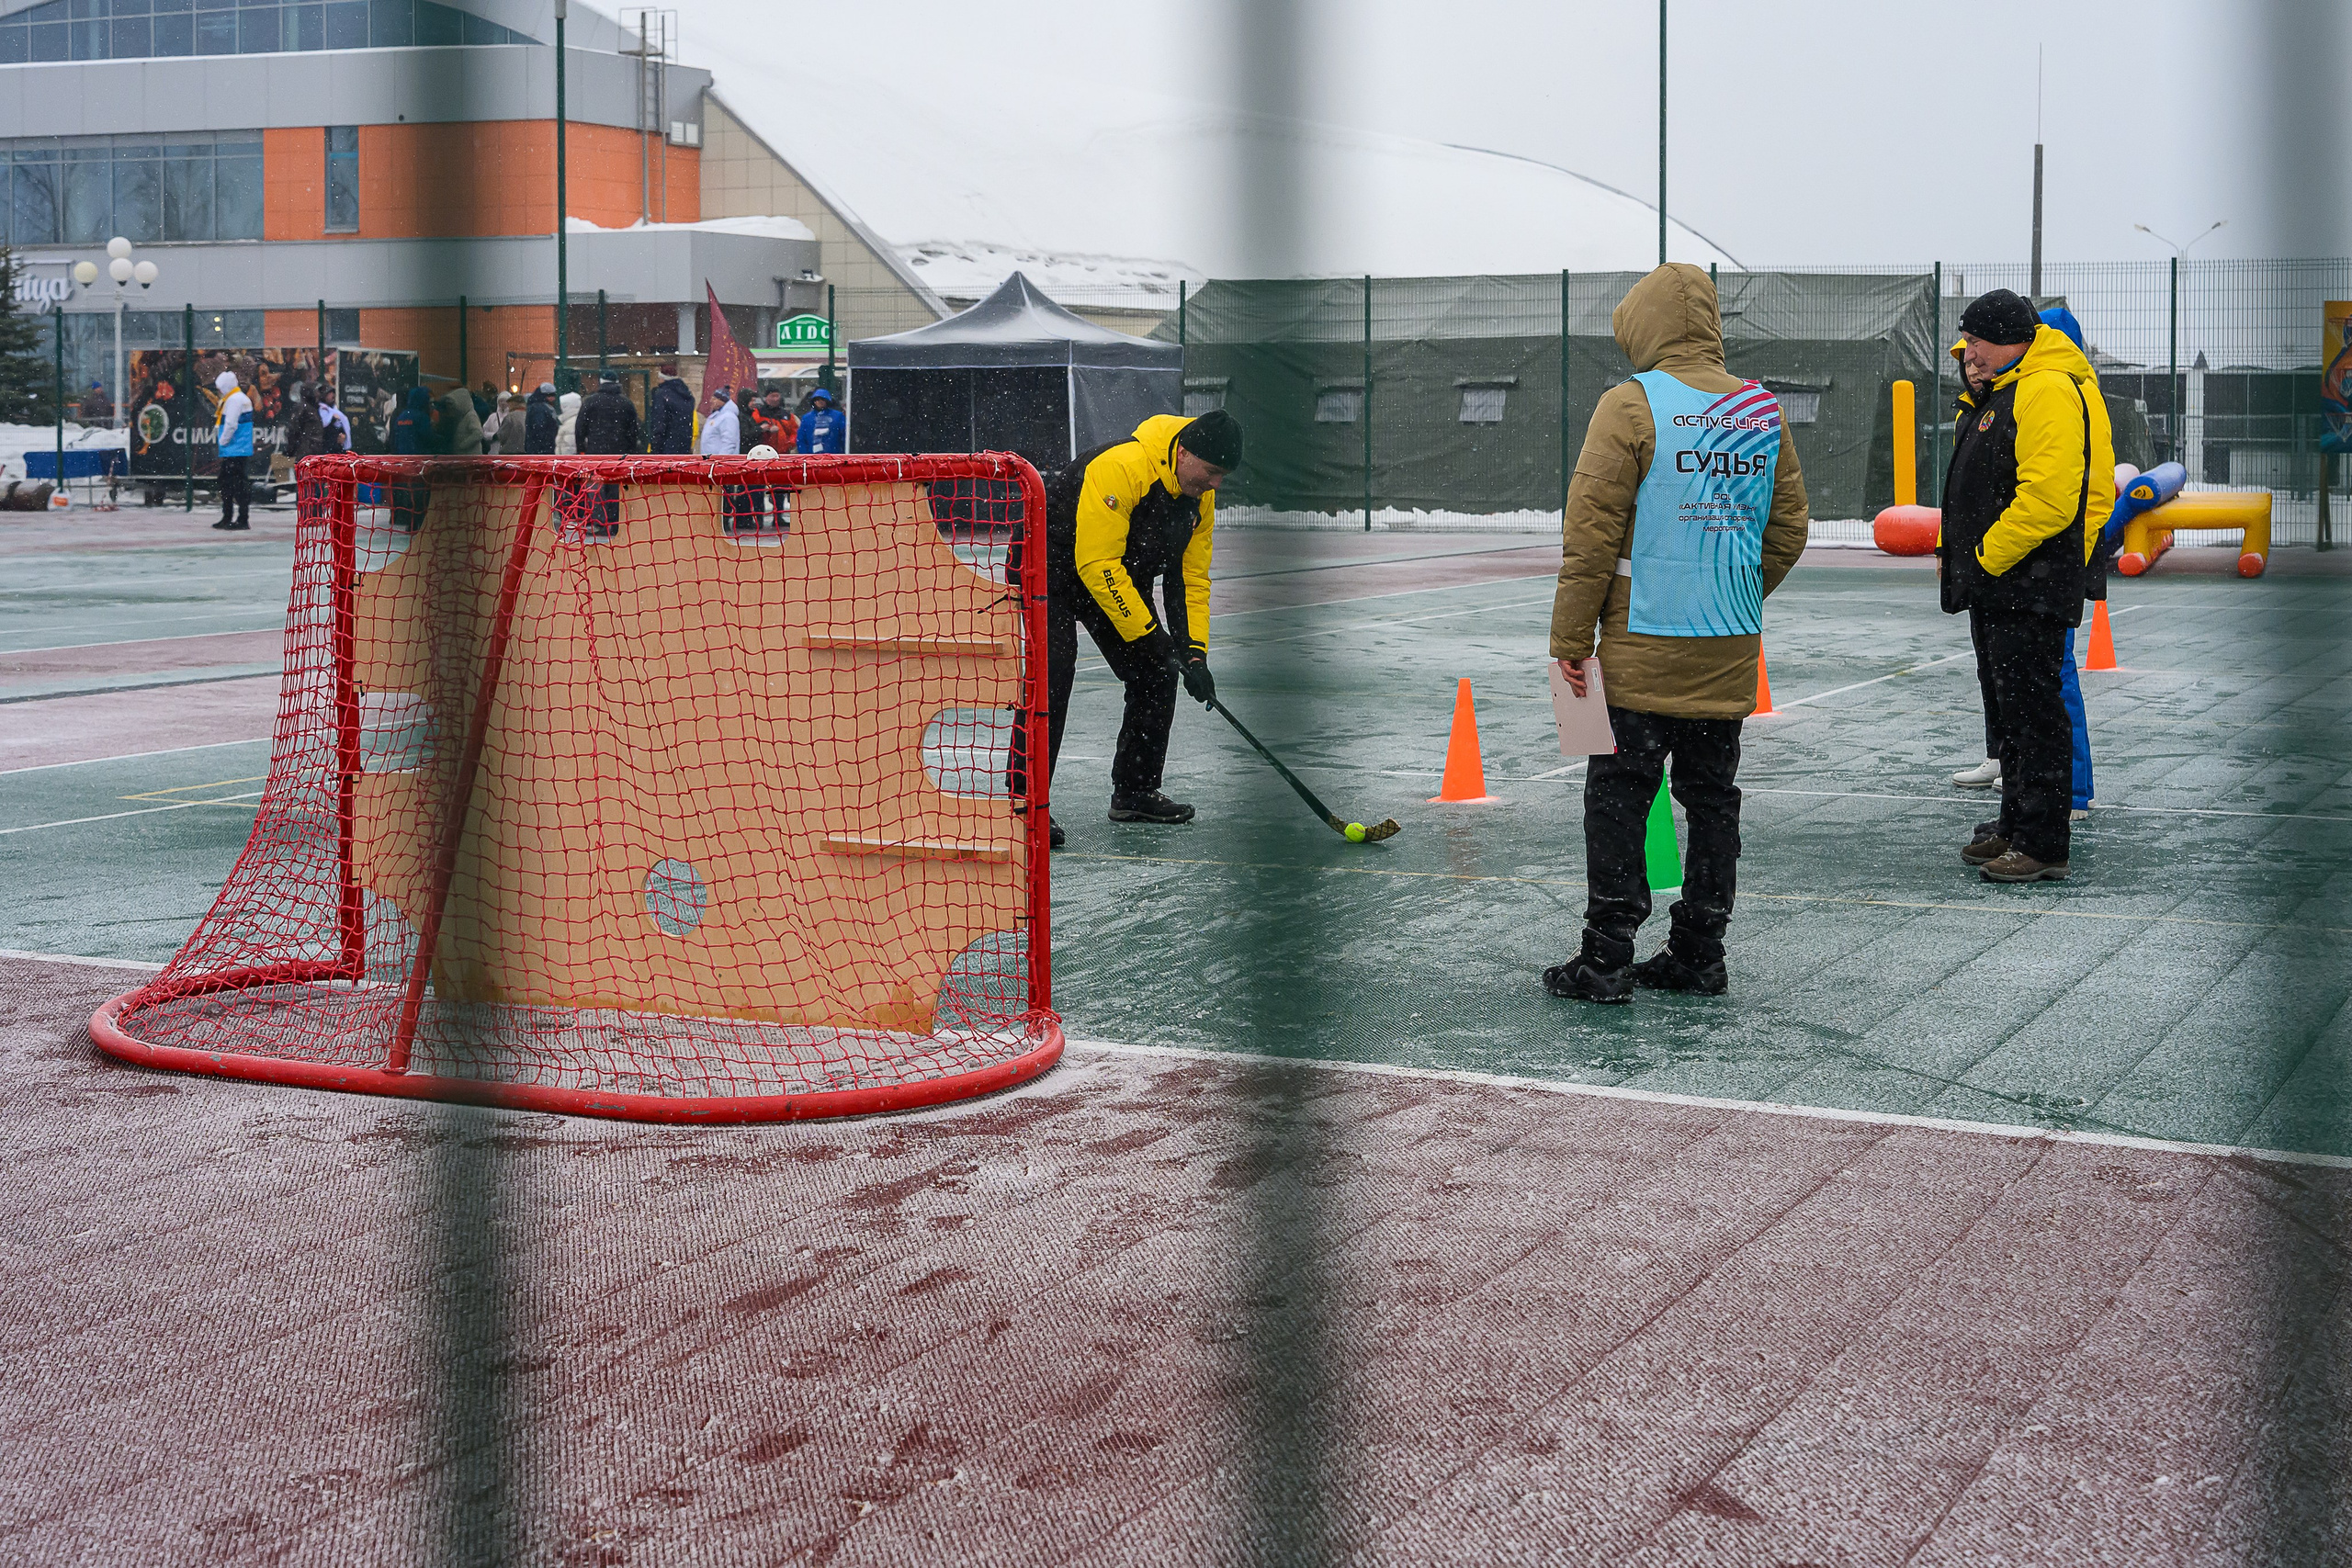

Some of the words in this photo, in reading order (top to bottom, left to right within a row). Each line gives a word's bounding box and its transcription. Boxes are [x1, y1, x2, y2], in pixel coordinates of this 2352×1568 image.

[1672, 415, 1733, 429] ACTIVE
[1735, 417, 1769, 432] LIFE
[1675, 450, 1768, 479] СУДЬЯ
[1103, 570, 1132, 618] BELARUS
